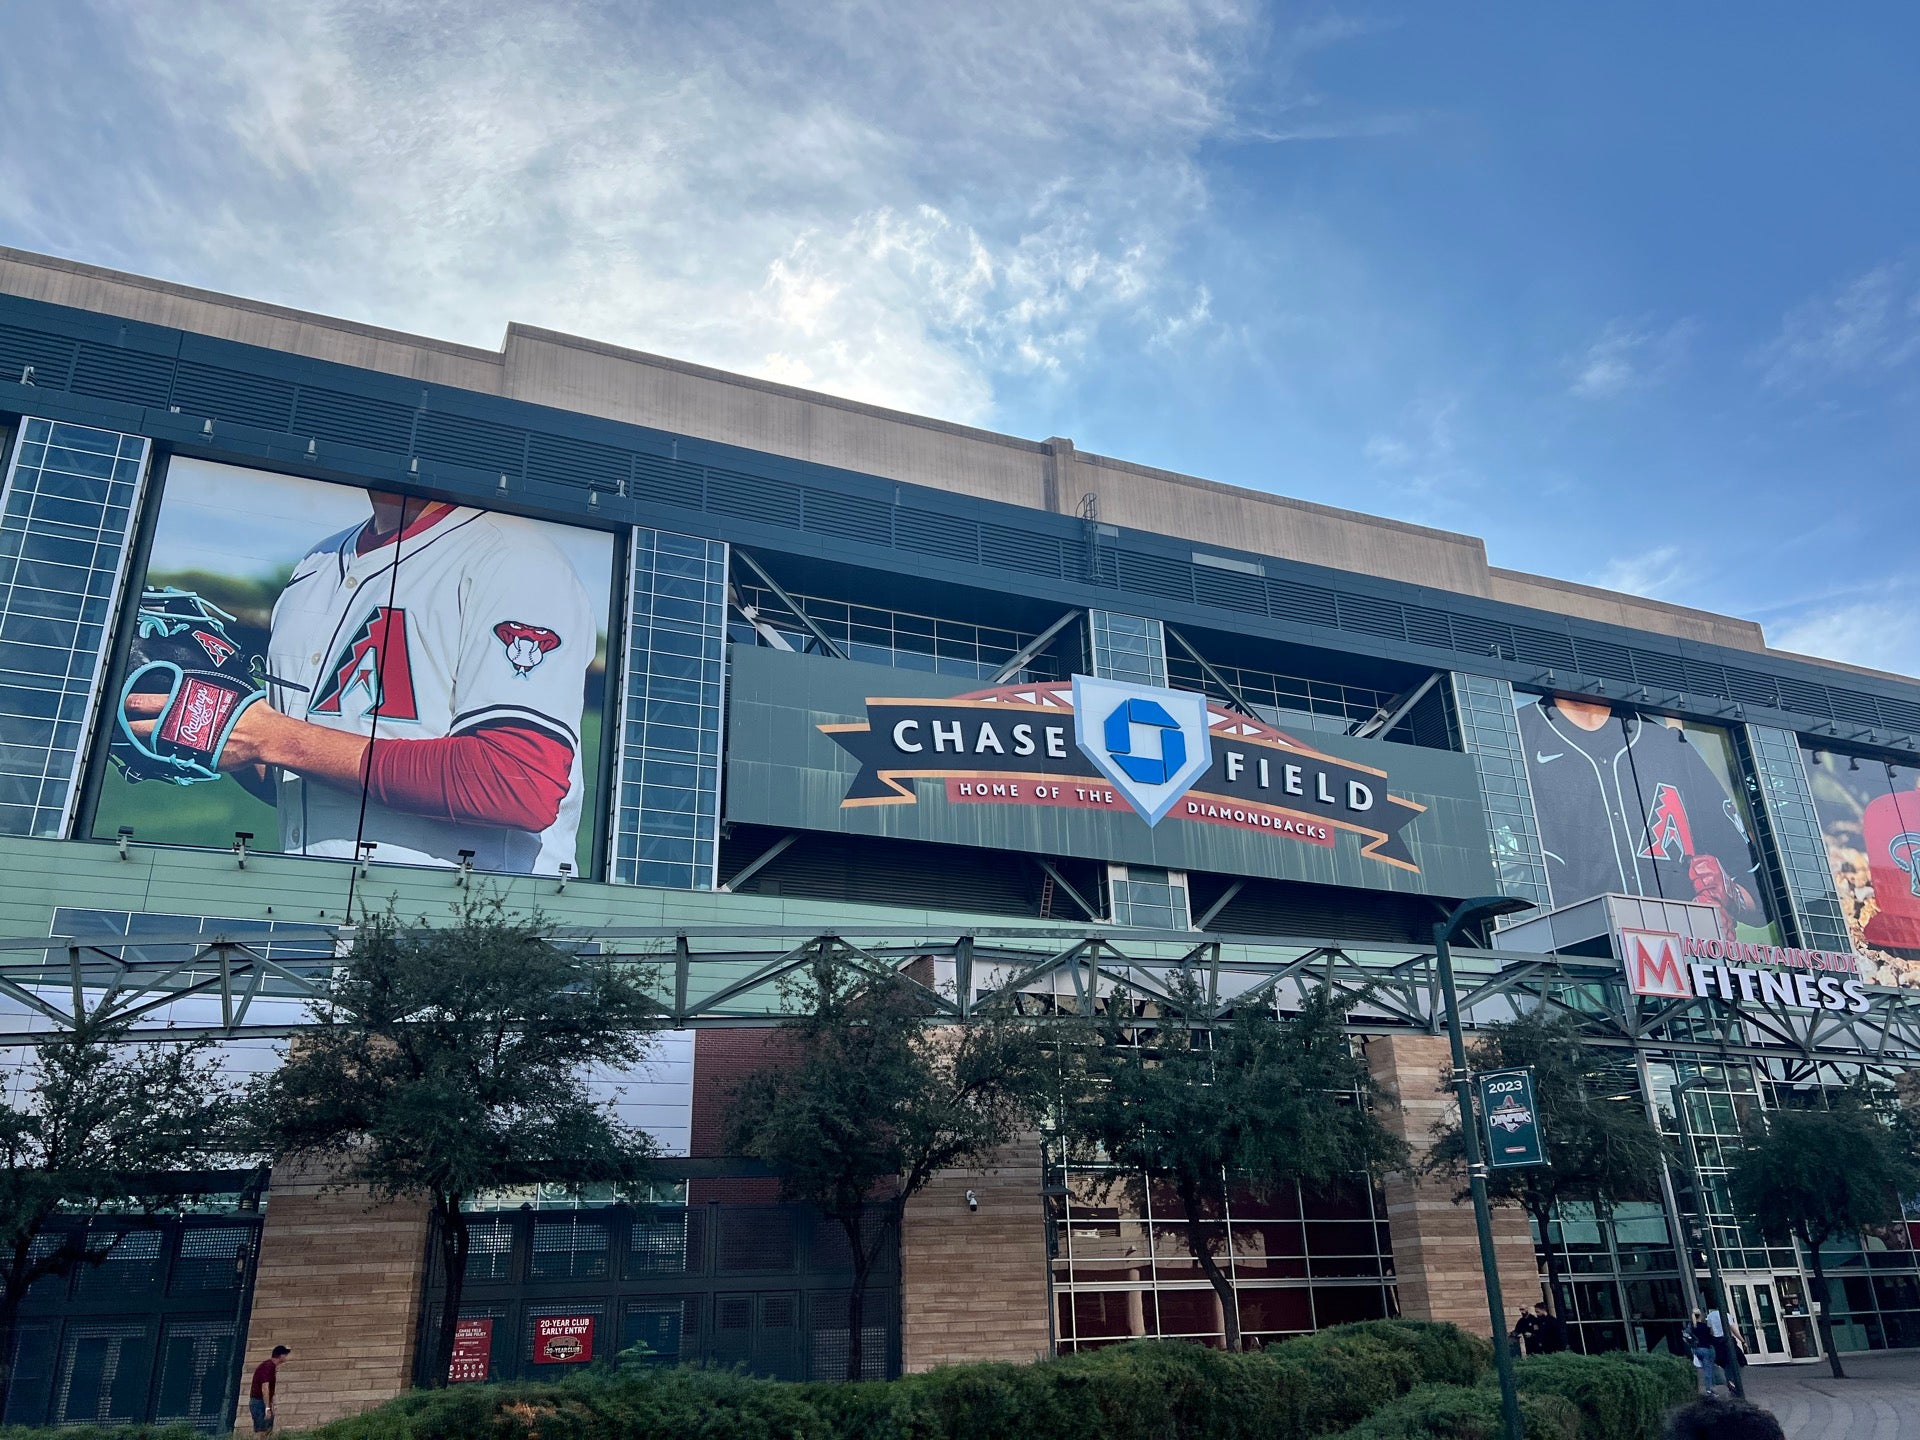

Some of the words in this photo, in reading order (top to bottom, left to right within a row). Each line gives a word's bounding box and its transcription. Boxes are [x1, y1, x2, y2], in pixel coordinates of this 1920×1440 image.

[181, 687, 214, 741] Rawlings
[892, 719, 1067, 759] CHASE
[1226, 751, 1374, 811] FIELD
[959, 783, 1019, 798] HOME
[1036, 786, 1060, 799] OF
[1075, 788, 1114, 804] THE
[1187, 801, 1327, 840] DIAMONDBACKS
[1634, 934, 1685, 992] M
[1684, 936, 1862, 975] MOUNTAINSIDE
[1690, 963, 1871, 1014] FITNESS
[1488, 1080, 1523, 1094] 2023
[540, 1319, 570, 1328] 20-YEAR
[571, 1318, 590, 1326] CLUB
[541, 1327, 563, 1335] EARLY
[564, 1326, 587, 1334] ENTRY
